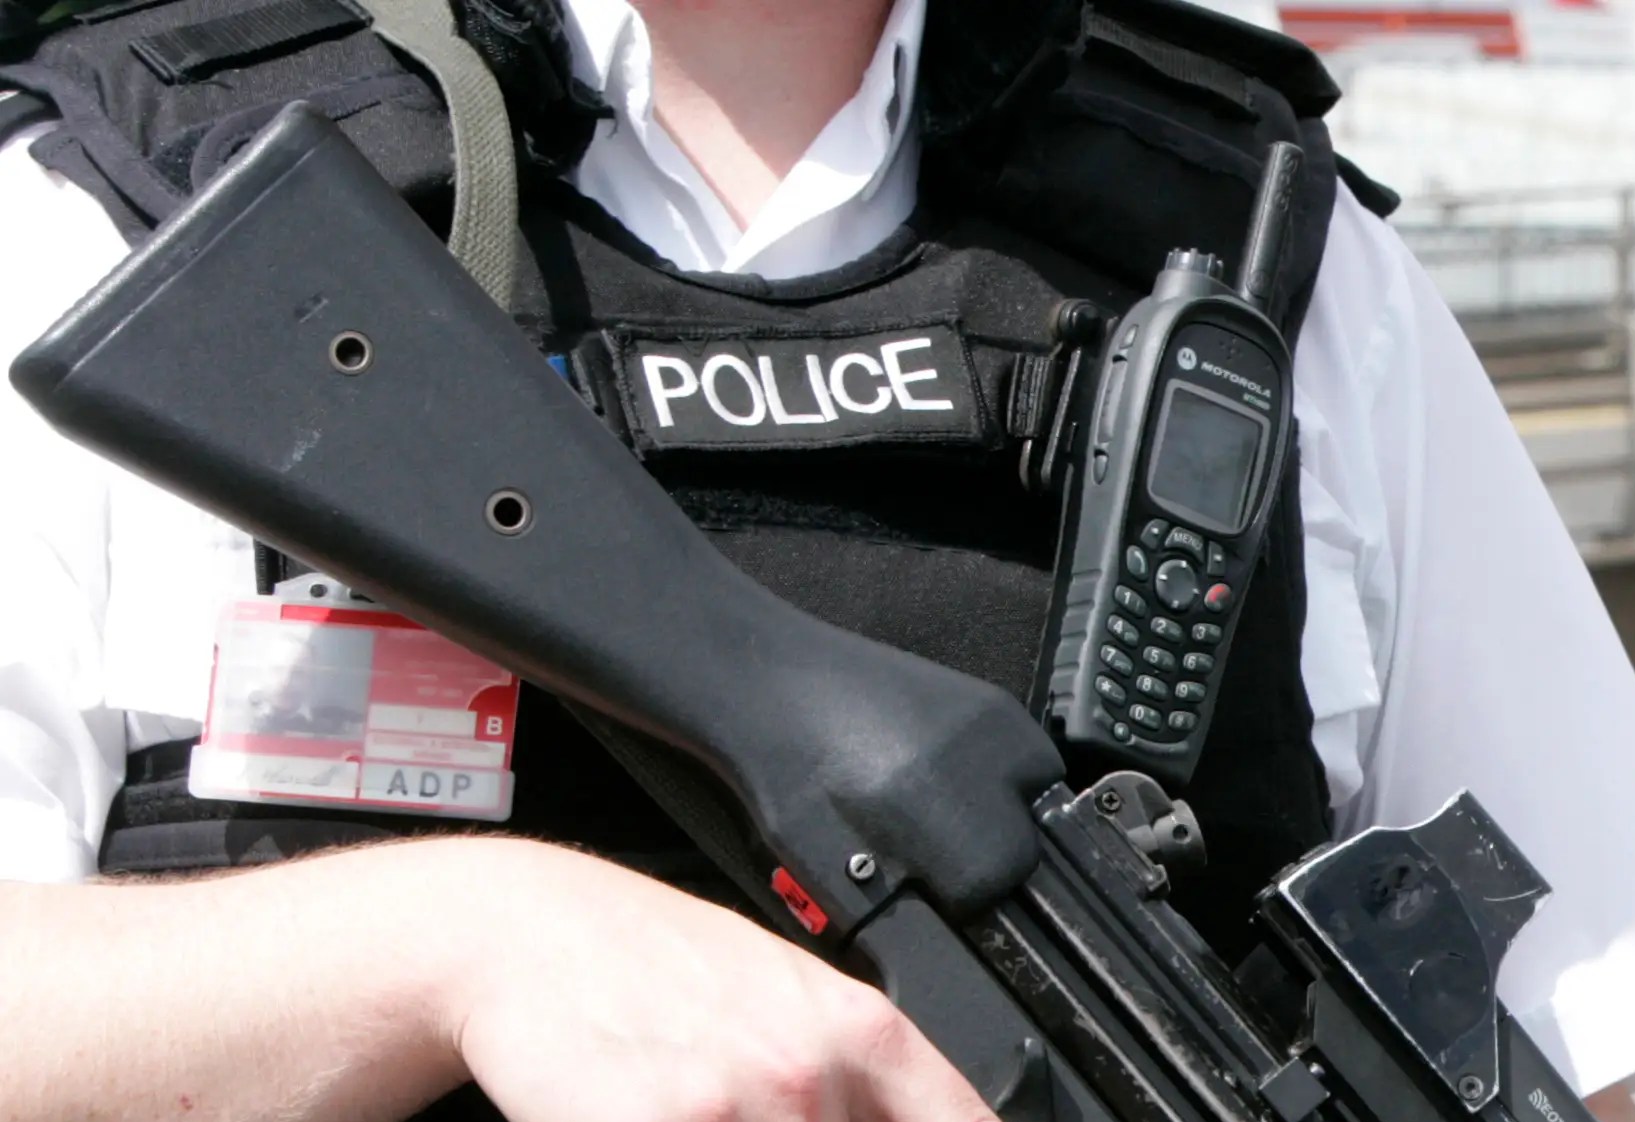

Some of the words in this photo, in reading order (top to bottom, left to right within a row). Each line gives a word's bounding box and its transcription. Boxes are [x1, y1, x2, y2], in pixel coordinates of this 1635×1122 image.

[642, 338, 953, 427] POLICE
[1200, 361, 1271, 399] MOTOROLA
[1173, 531, 1203, 551] MENU
[1124, 591, 1131, 605] 1
[1155, 619, 1167, 634] 2
[1197, 626, 1206, 640] 3
[1113, 619, 1124, 634] 4
[1150, 650, 1160, 664] 5
[1187, 655, 1197, 669] 6
[1106, 647, 1116, 662] 7
[1142, 677, 1152, 692] 8
[1178, 685, 1188, 698] 9
[486, 716, 503, 736] B
